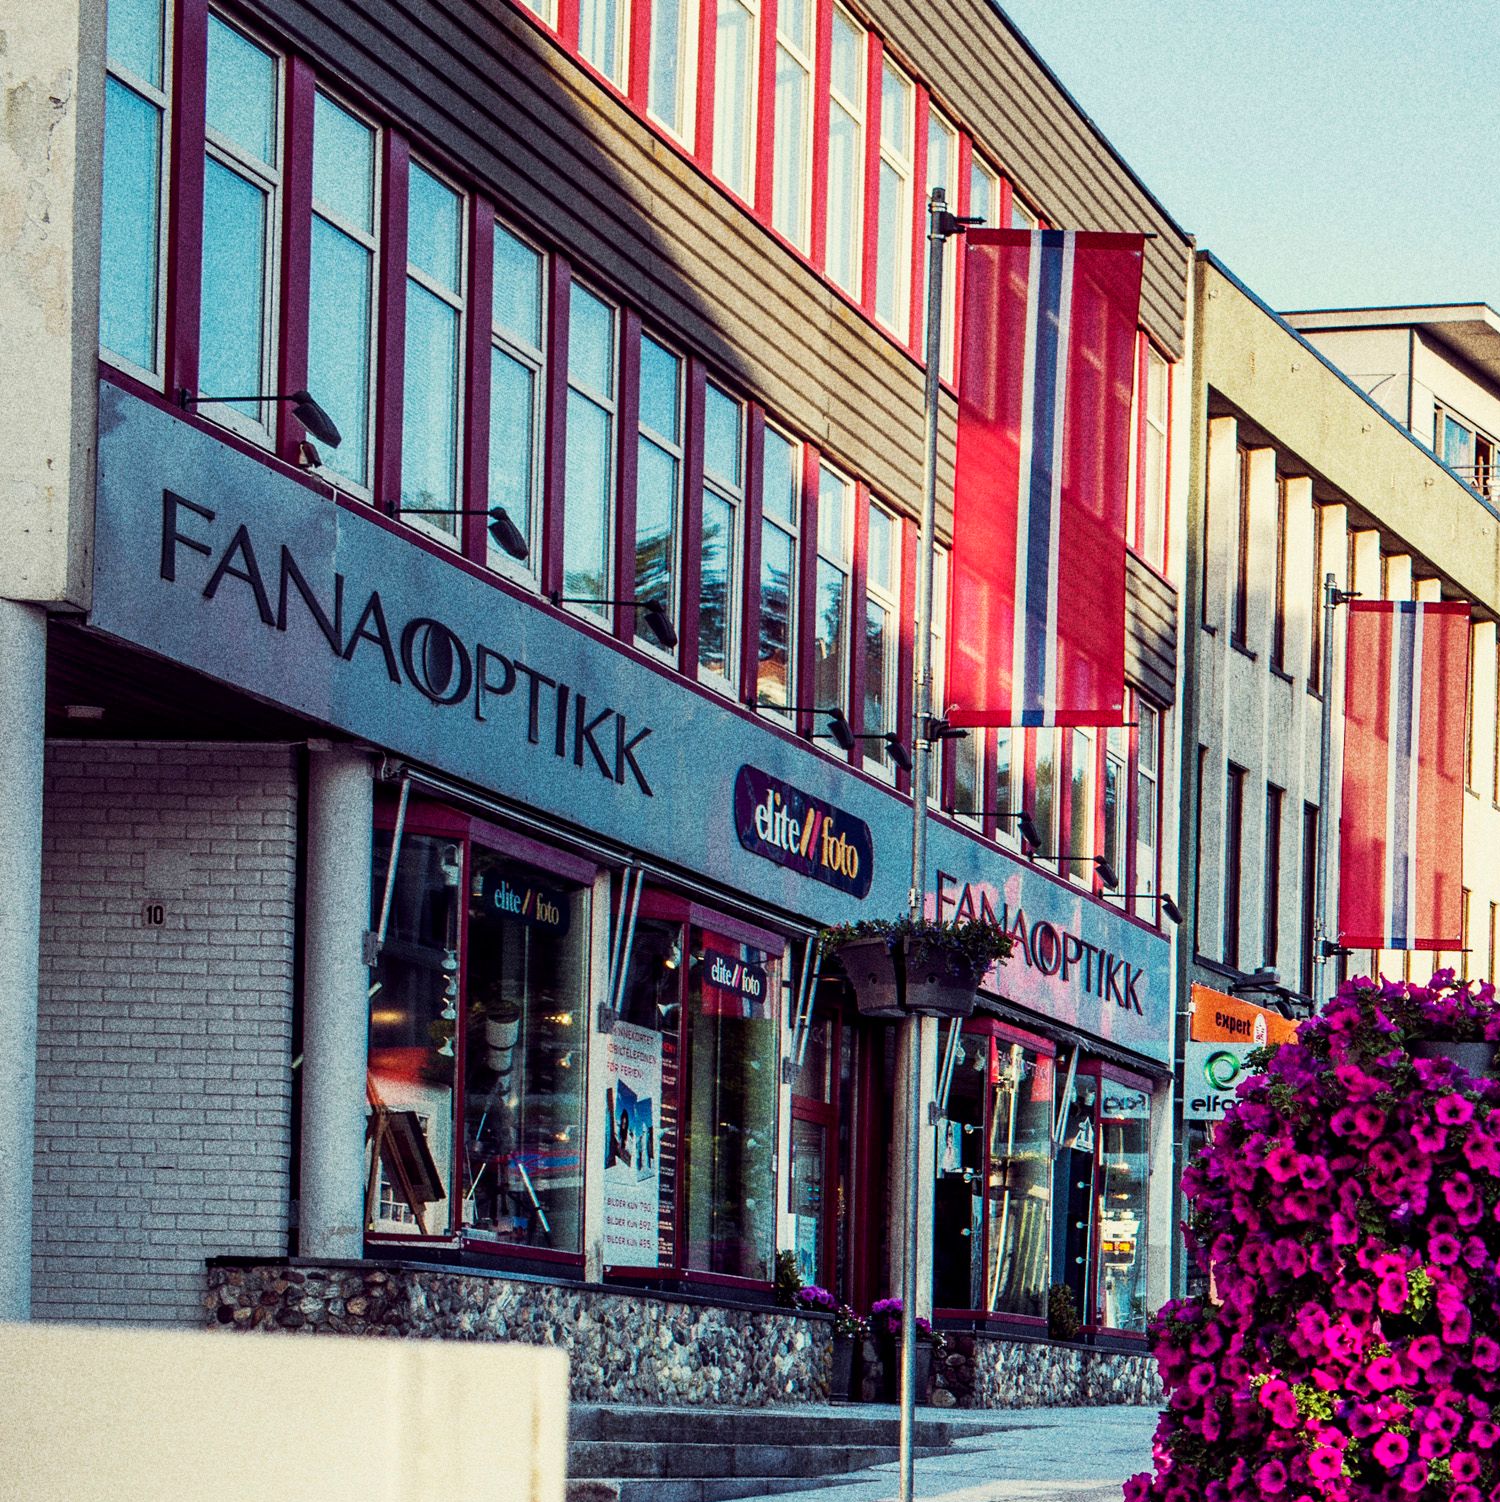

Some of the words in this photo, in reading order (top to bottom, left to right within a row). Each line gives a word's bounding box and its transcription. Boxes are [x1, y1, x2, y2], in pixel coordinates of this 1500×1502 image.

[821, 816, 859, 879] foto
[147, 905, 164, 925] 10
[535, 893, 560, 925] foto
[741, 968, 761, 996] foto
[1215, 1011, 1251, 1036] expert
